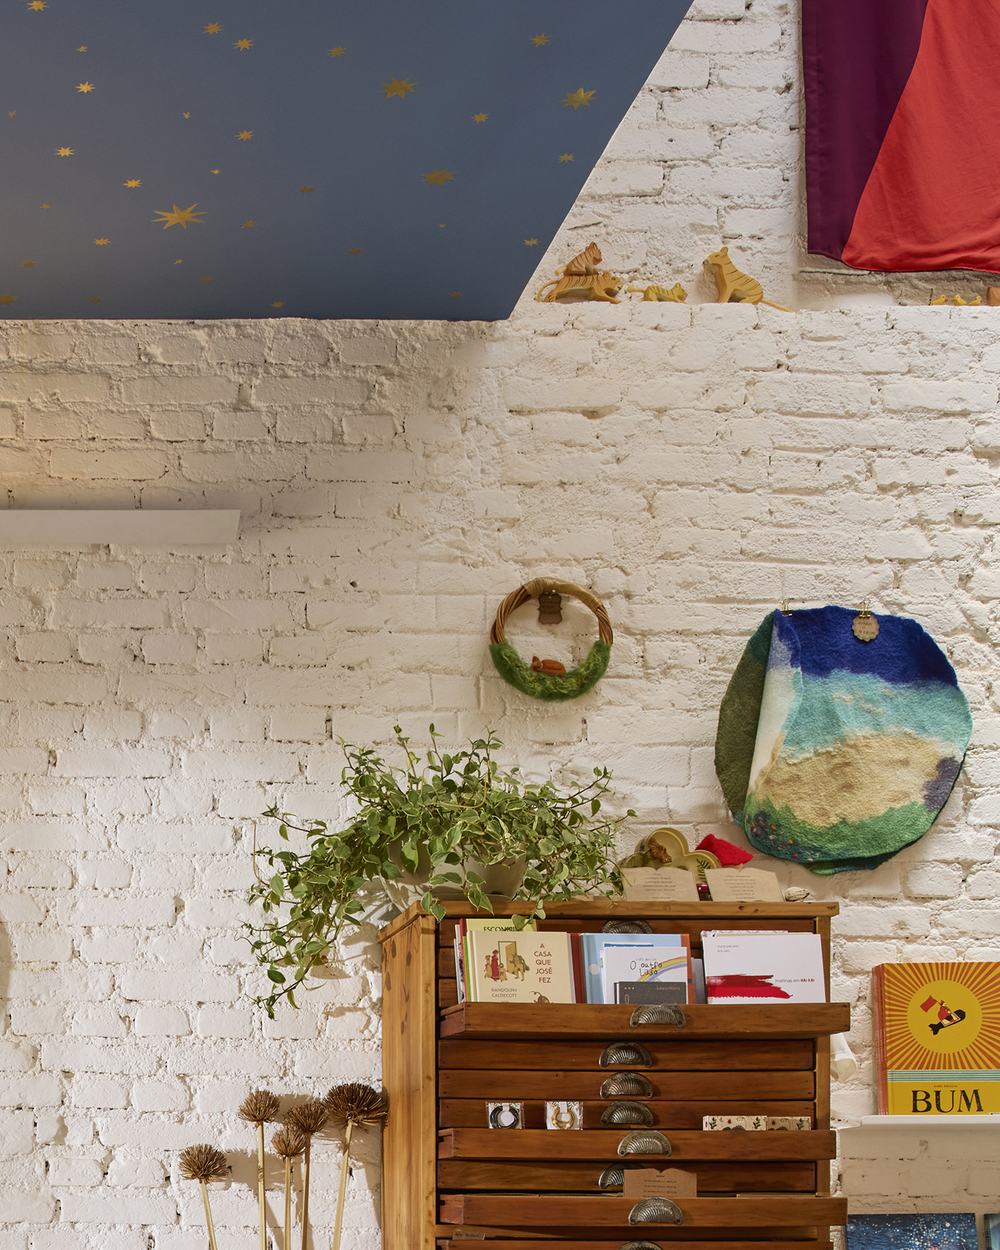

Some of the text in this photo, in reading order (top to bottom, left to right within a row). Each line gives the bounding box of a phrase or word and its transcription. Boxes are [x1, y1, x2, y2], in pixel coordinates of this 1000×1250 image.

[629, 960, 637, 970] O
[535, 967, 553, 975] JOSÉ
[911, 1089, 984, 1113] BUM
